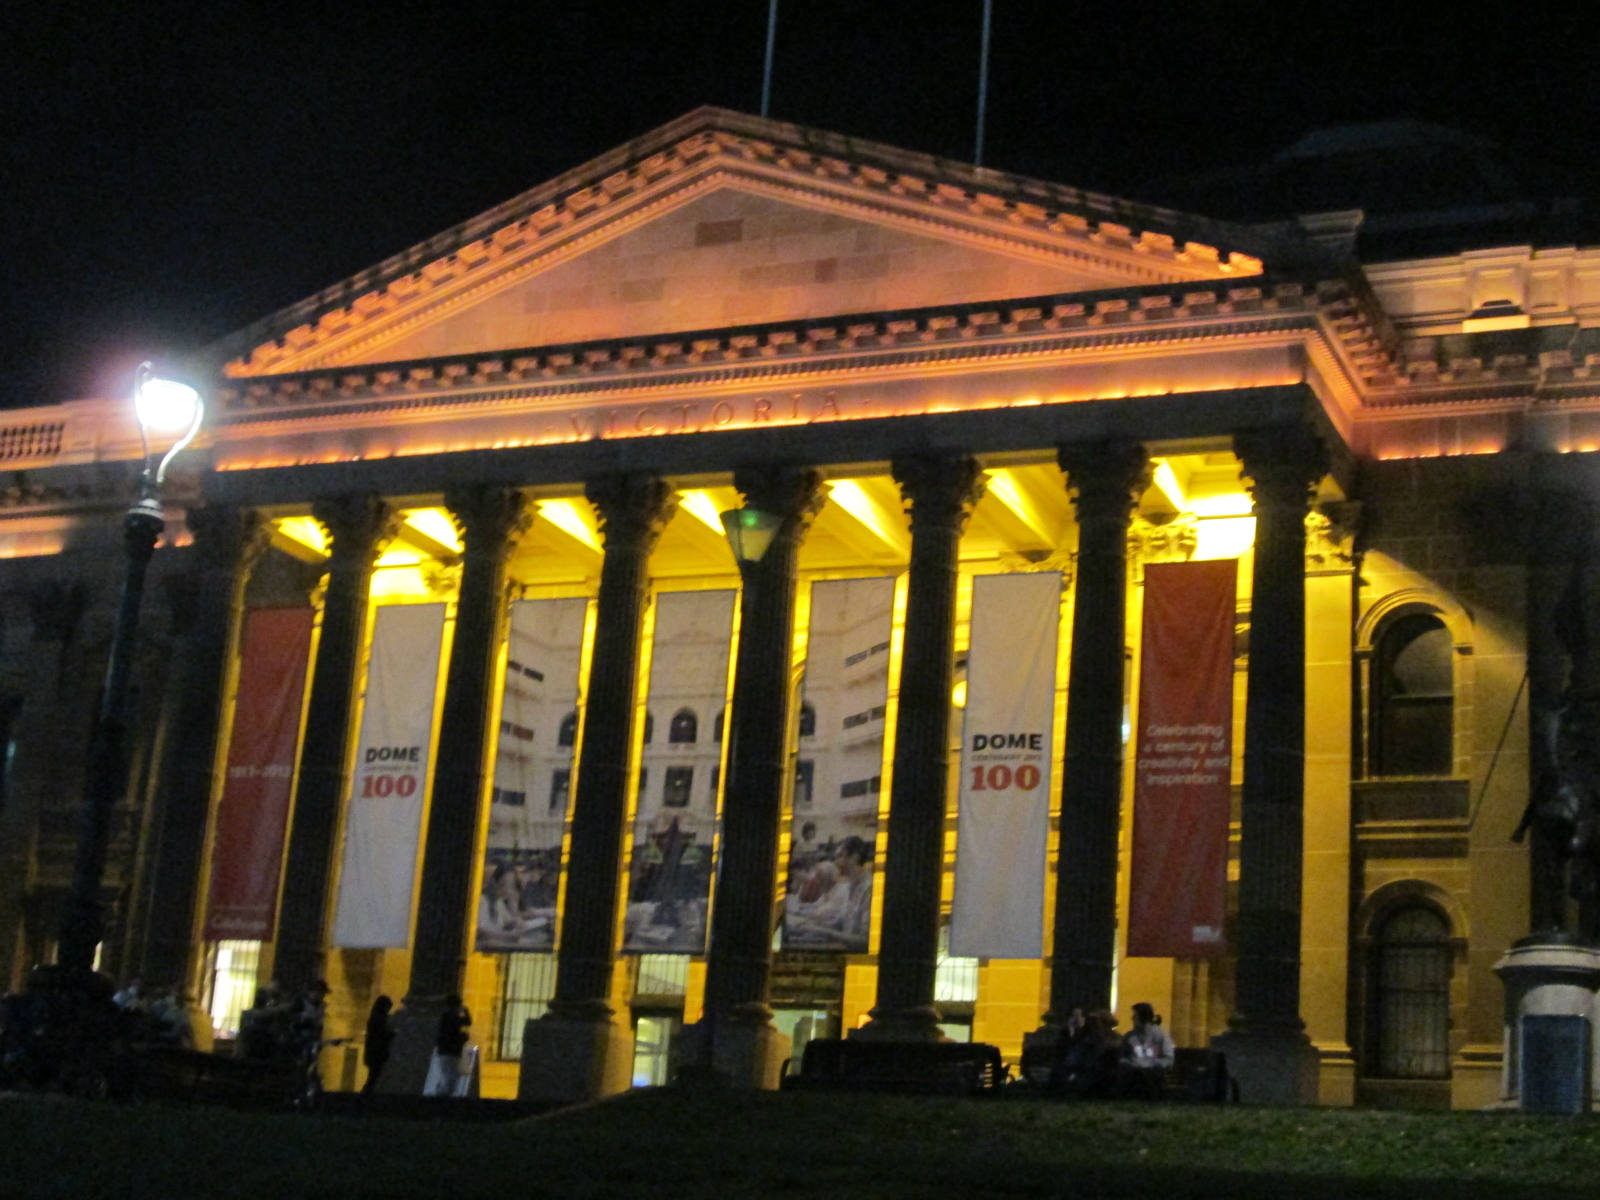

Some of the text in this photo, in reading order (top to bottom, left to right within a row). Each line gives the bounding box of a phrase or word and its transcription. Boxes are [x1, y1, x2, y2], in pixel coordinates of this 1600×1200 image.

[569, 391, 841, 438] VICTORIA
[1145, 723, 1224, 738] Celebrating
[972, 733, 1043, 751] DOME
[1155, 742, 1208, 754] century
[1211, 739, 1226, 752] of
[365, 746, 421, 762] DOME
[361, 774, 417, 799] 100
[969, 764, 1042, 791] 100
